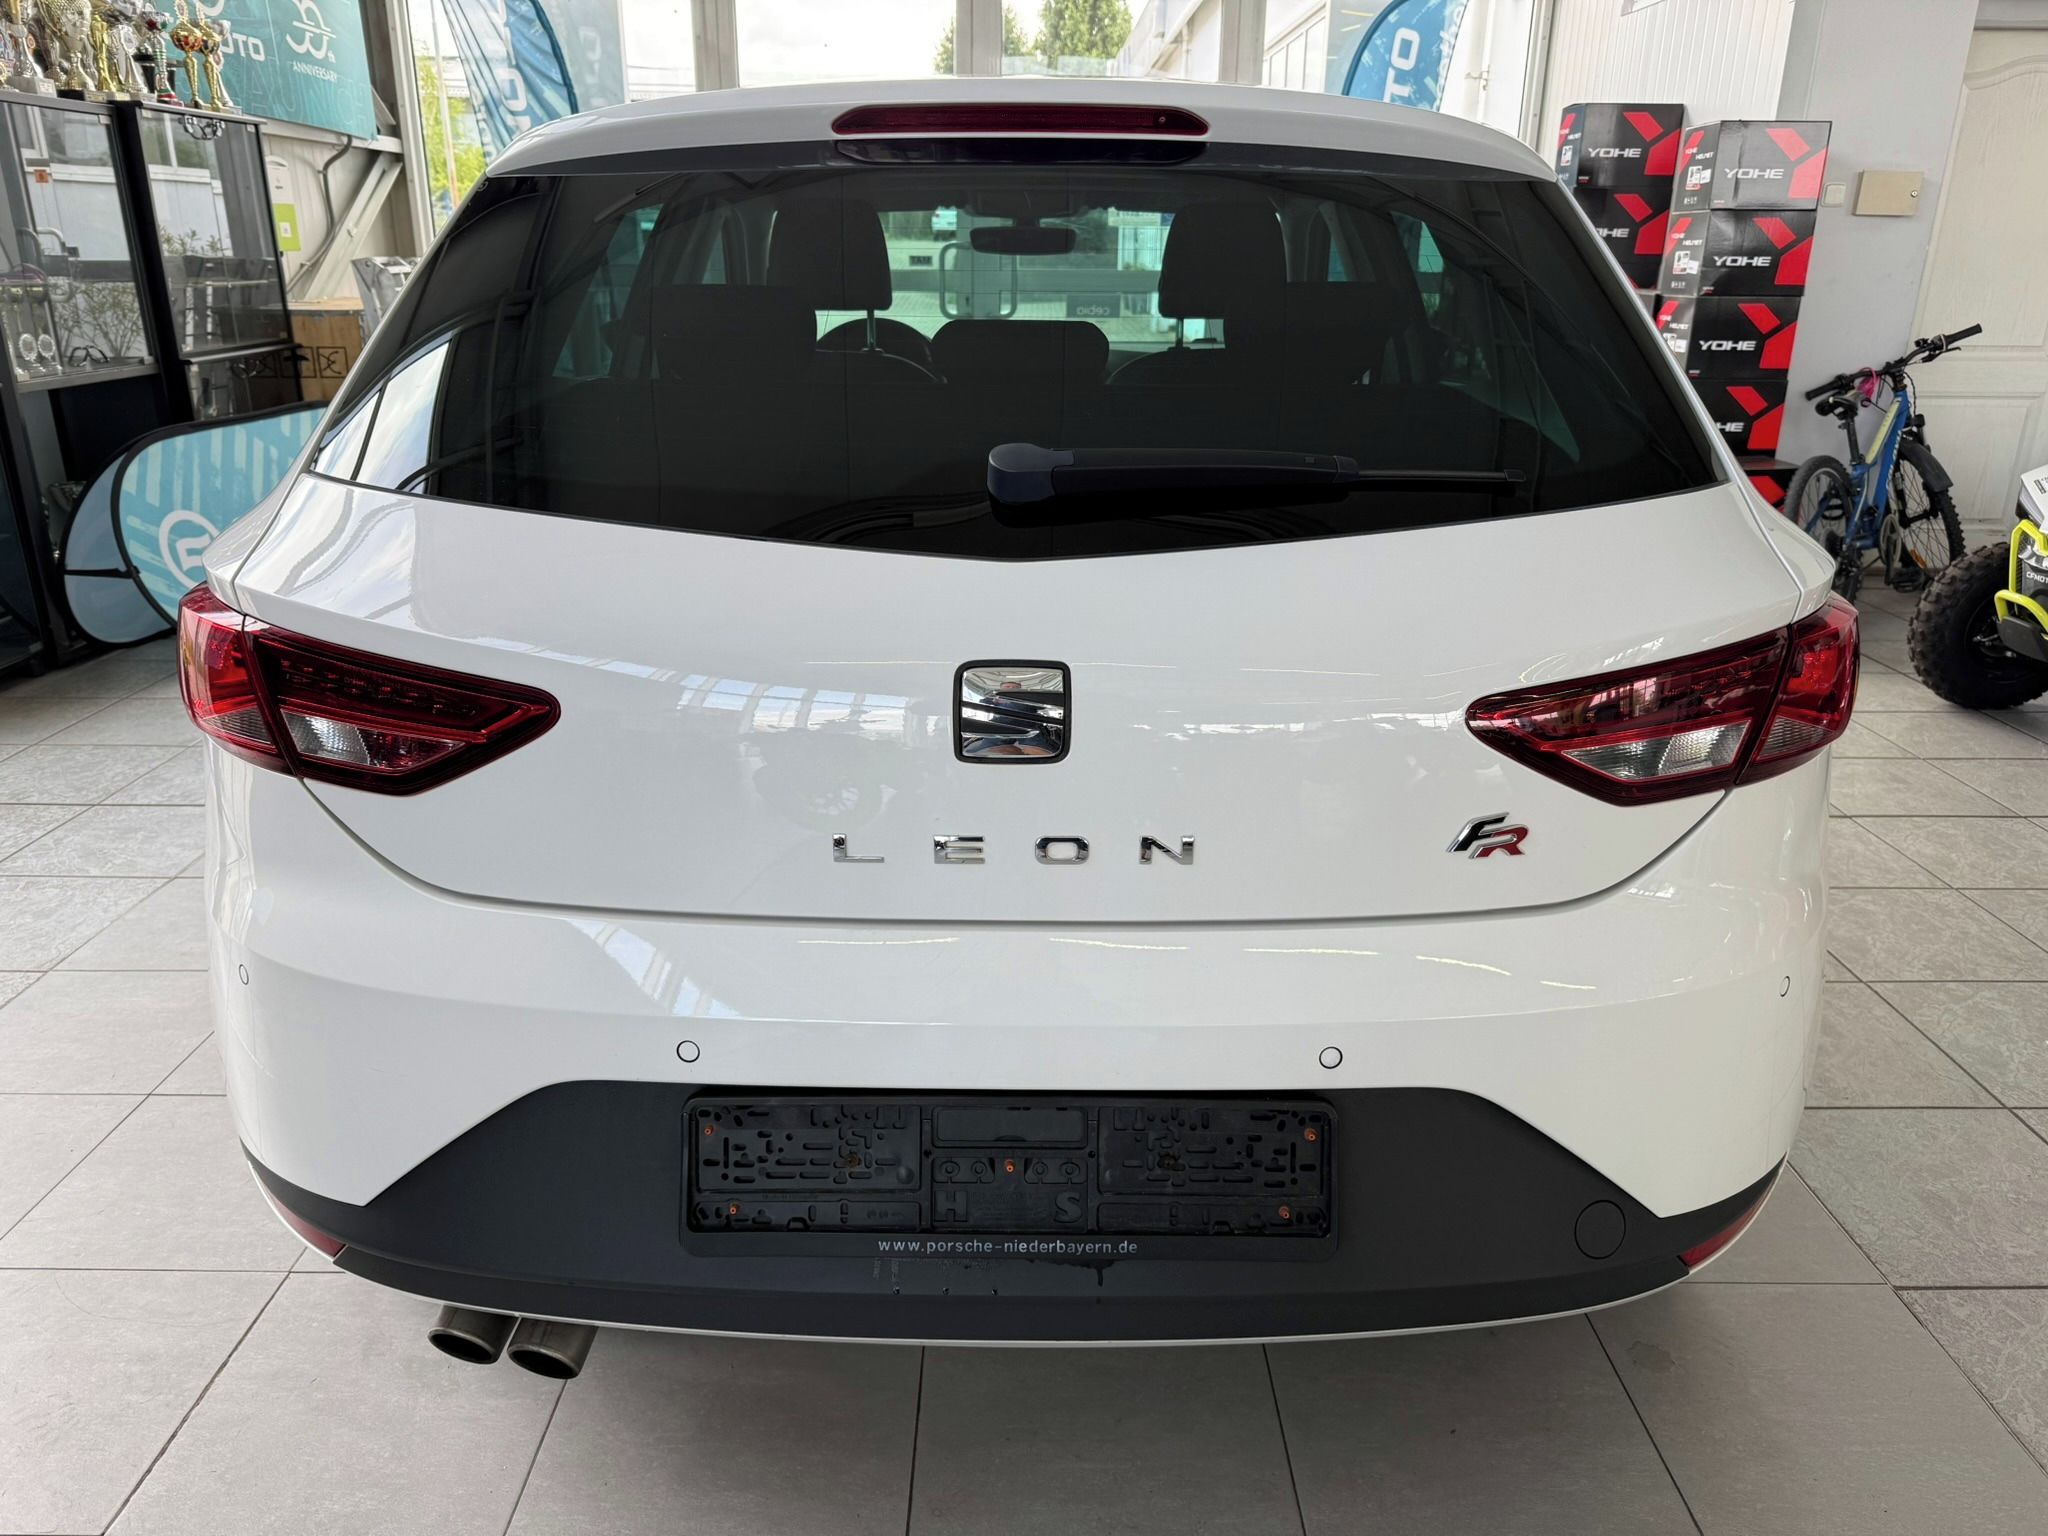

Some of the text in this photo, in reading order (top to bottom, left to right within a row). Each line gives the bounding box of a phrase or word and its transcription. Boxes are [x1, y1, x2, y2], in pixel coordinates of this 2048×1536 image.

[1588, 148, 1642, 158] YOHE
[1724, 168, 1785, 179] YOHE
[1713, 256, 1772, 267] YOHE
[1699, 340, 1757, 351] YOHE
[1446, 812, 1530, 860] FR
[832, 833, 1195, 866] LEON
[878, 1238, 1138, 1255] www.porsche-niederbayern.de
